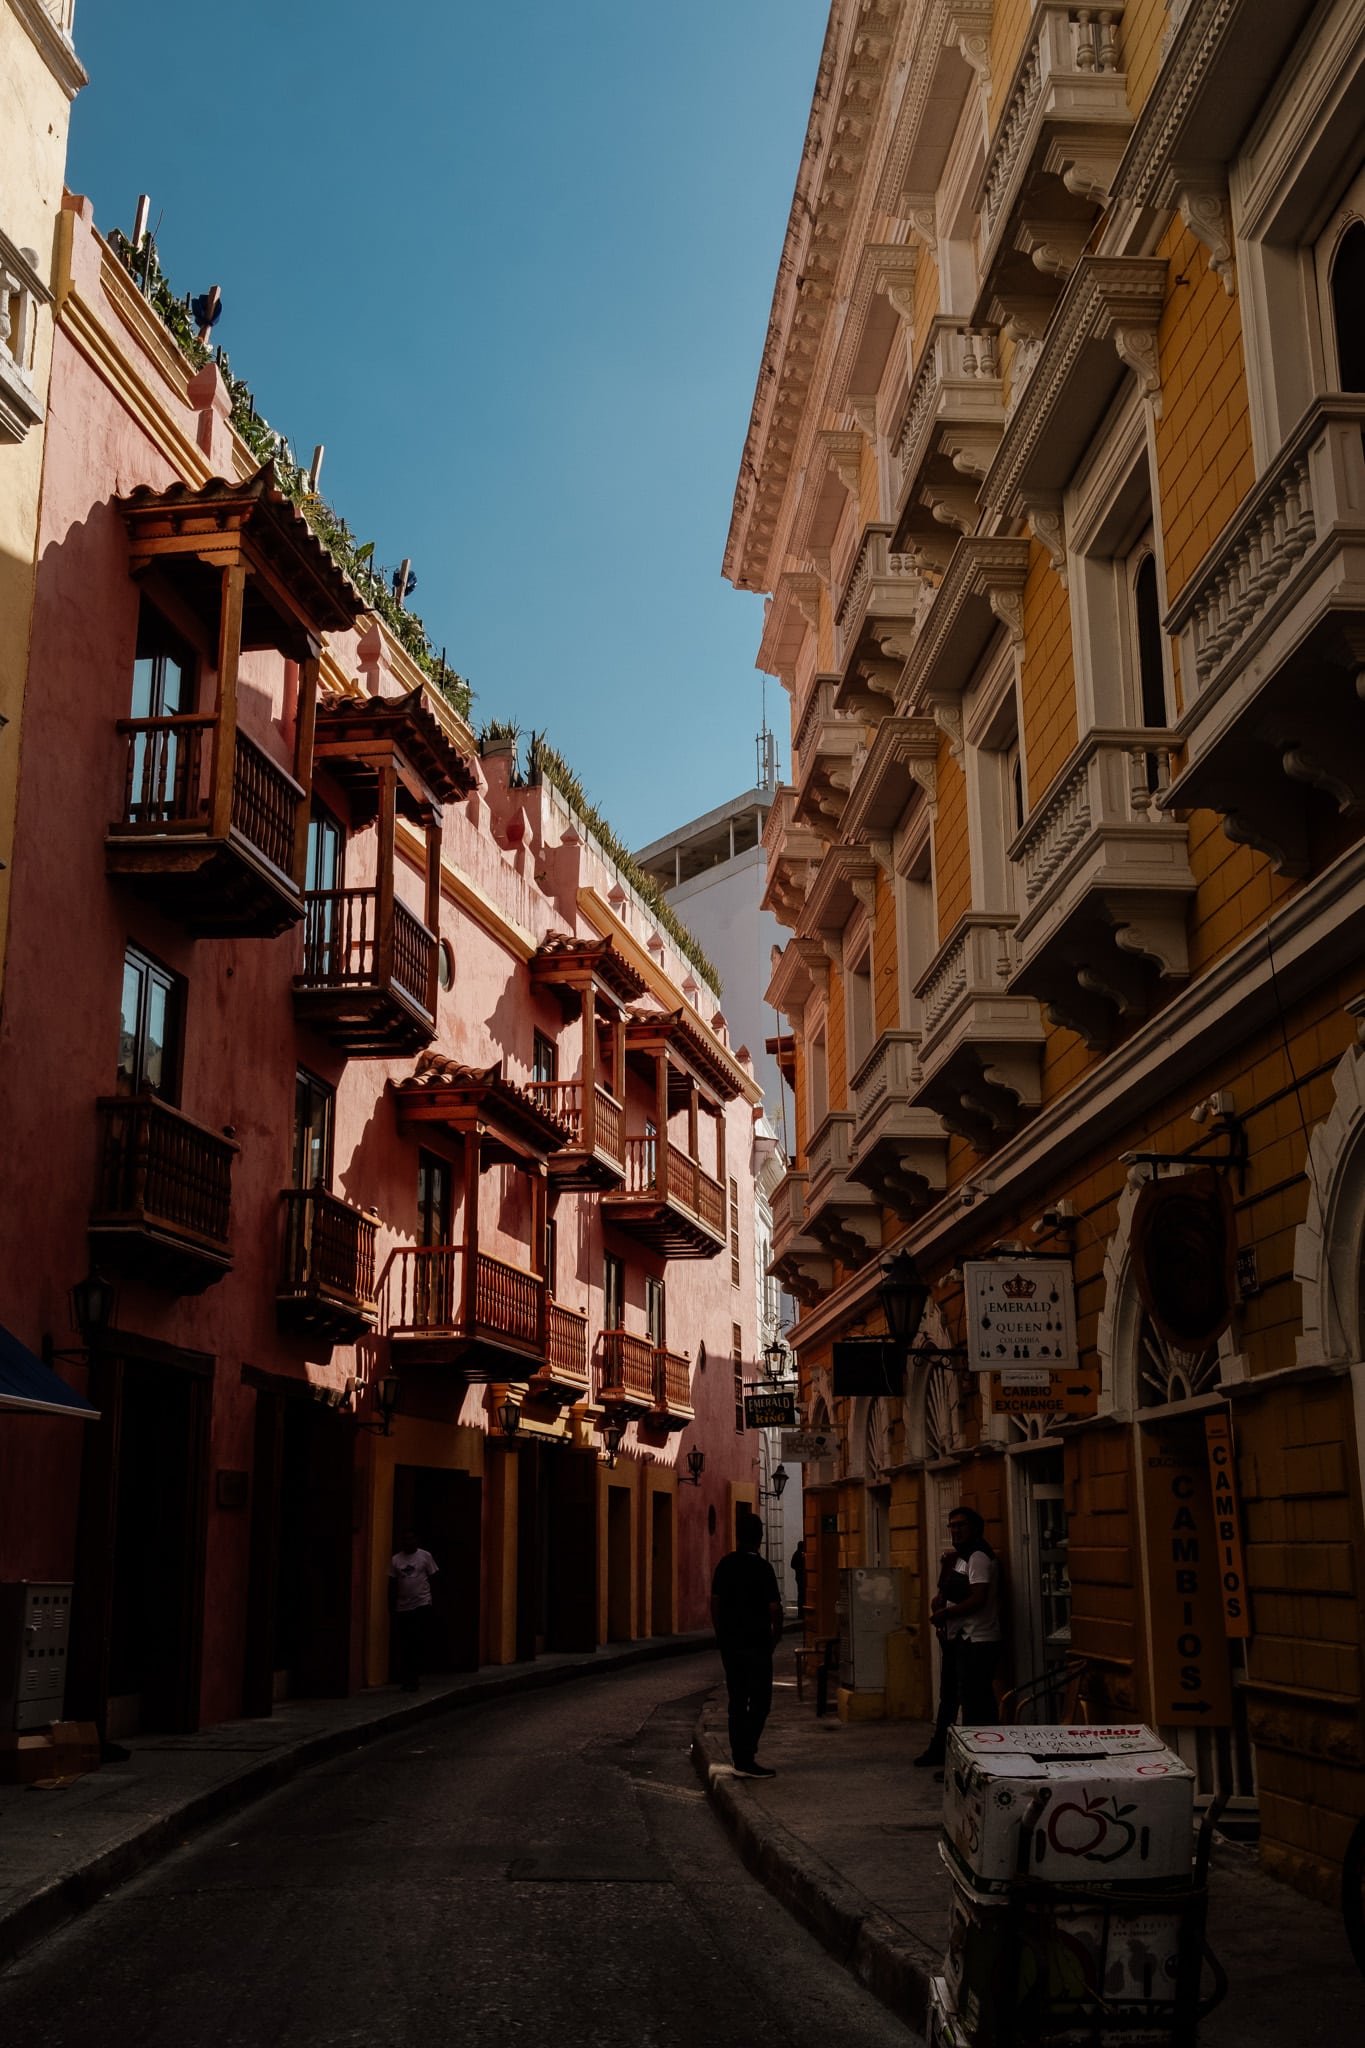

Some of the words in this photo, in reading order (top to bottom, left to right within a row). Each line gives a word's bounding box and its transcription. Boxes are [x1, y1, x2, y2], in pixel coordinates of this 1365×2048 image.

[989, 1302, 1051, 1313] EMERALD
[996, 1323, 1042, 1334] QUEEN
[1002, 1386, 1051, 1397] CAMBIO
[748, 1397, 790, 1412] EMERALD
[995, 1400, 1065, 1411] EXCHANGE
[755, 1412, 786, 1424] KING
[1212, 1446, 1241, 1618] CAMBIOS
[1172, 1475, 1201, 1691] CAMBIOS
